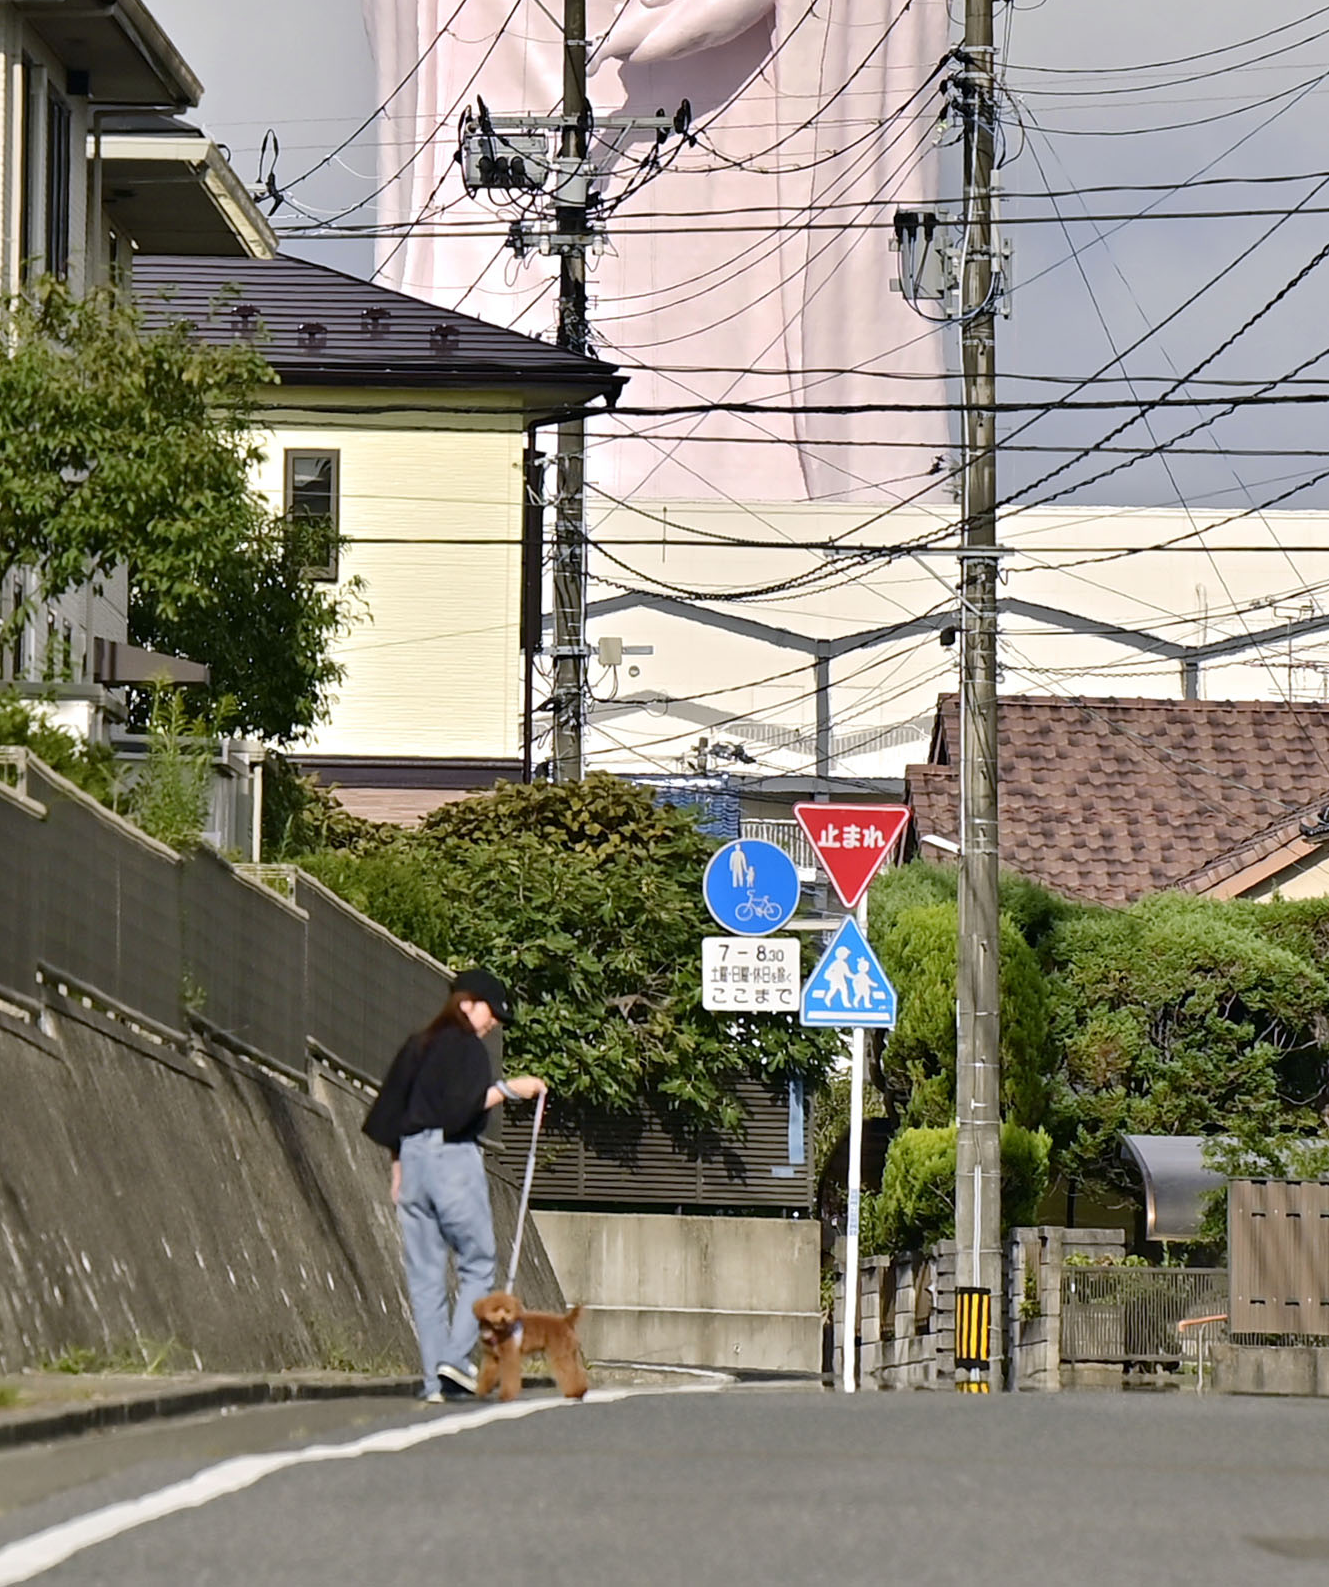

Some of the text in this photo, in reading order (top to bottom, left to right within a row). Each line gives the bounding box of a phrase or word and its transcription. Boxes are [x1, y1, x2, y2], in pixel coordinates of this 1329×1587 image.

[817, 823, 886, 849] 止まれ
[712, 987, 793, 1005] ここまで
